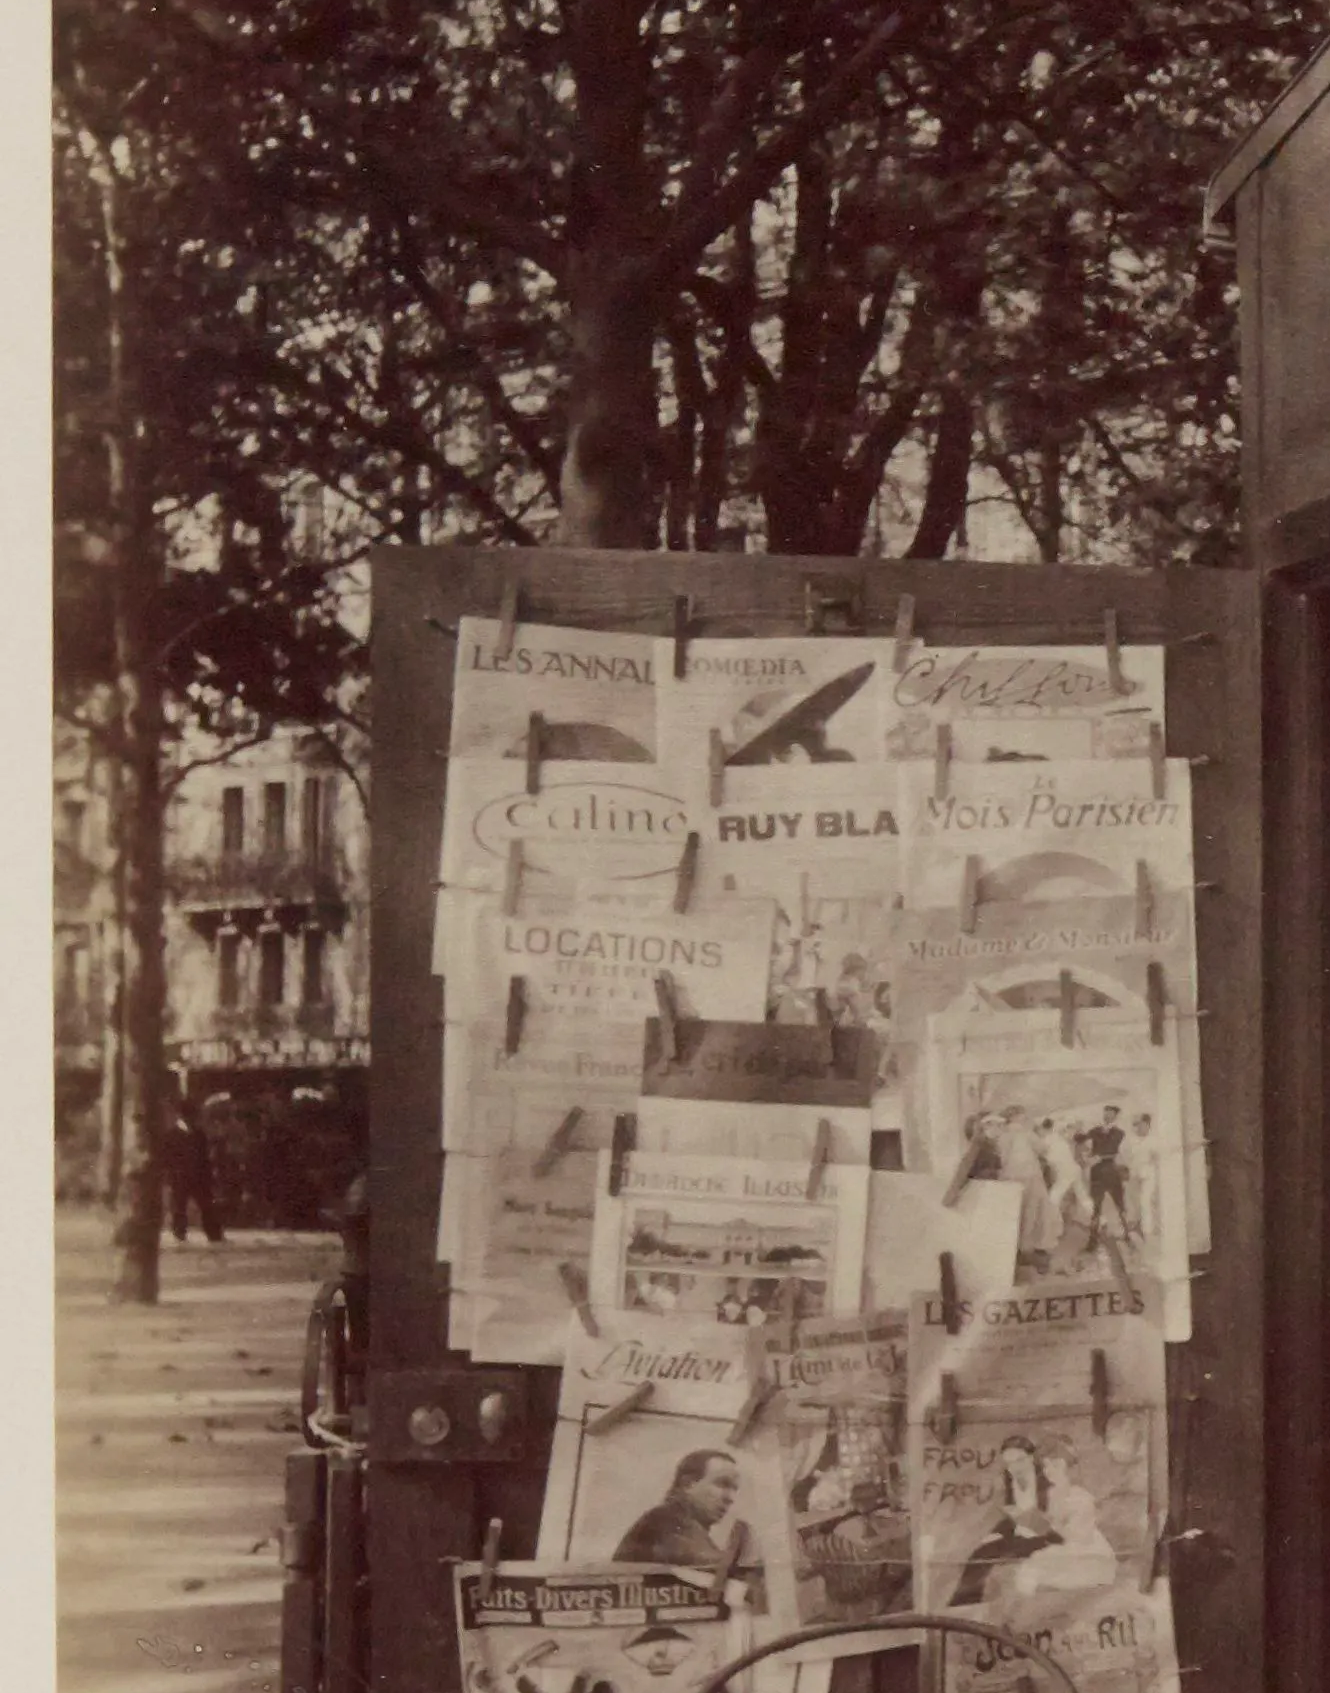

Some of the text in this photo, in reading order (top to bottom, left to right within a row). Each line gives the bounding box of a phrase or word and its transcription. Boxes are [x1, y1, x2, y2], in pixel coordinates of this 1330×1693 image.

[539, 650, 657, 686] ANNAL
[893, 650, 1140, 708] Chiffon
[718, 809, 900, 843] RUY BLA
[927, 793, 1179, 832] Mois Parisien
[504, 925, 724, 969] LOCATIONS
[908, 938, 1018, 961] Madame
[924, 1290, 1145, 1326] LS GAZETTES
[922, 1446, 1000, 1470] FROU
[922, 1480, 995, 1505] FROU
